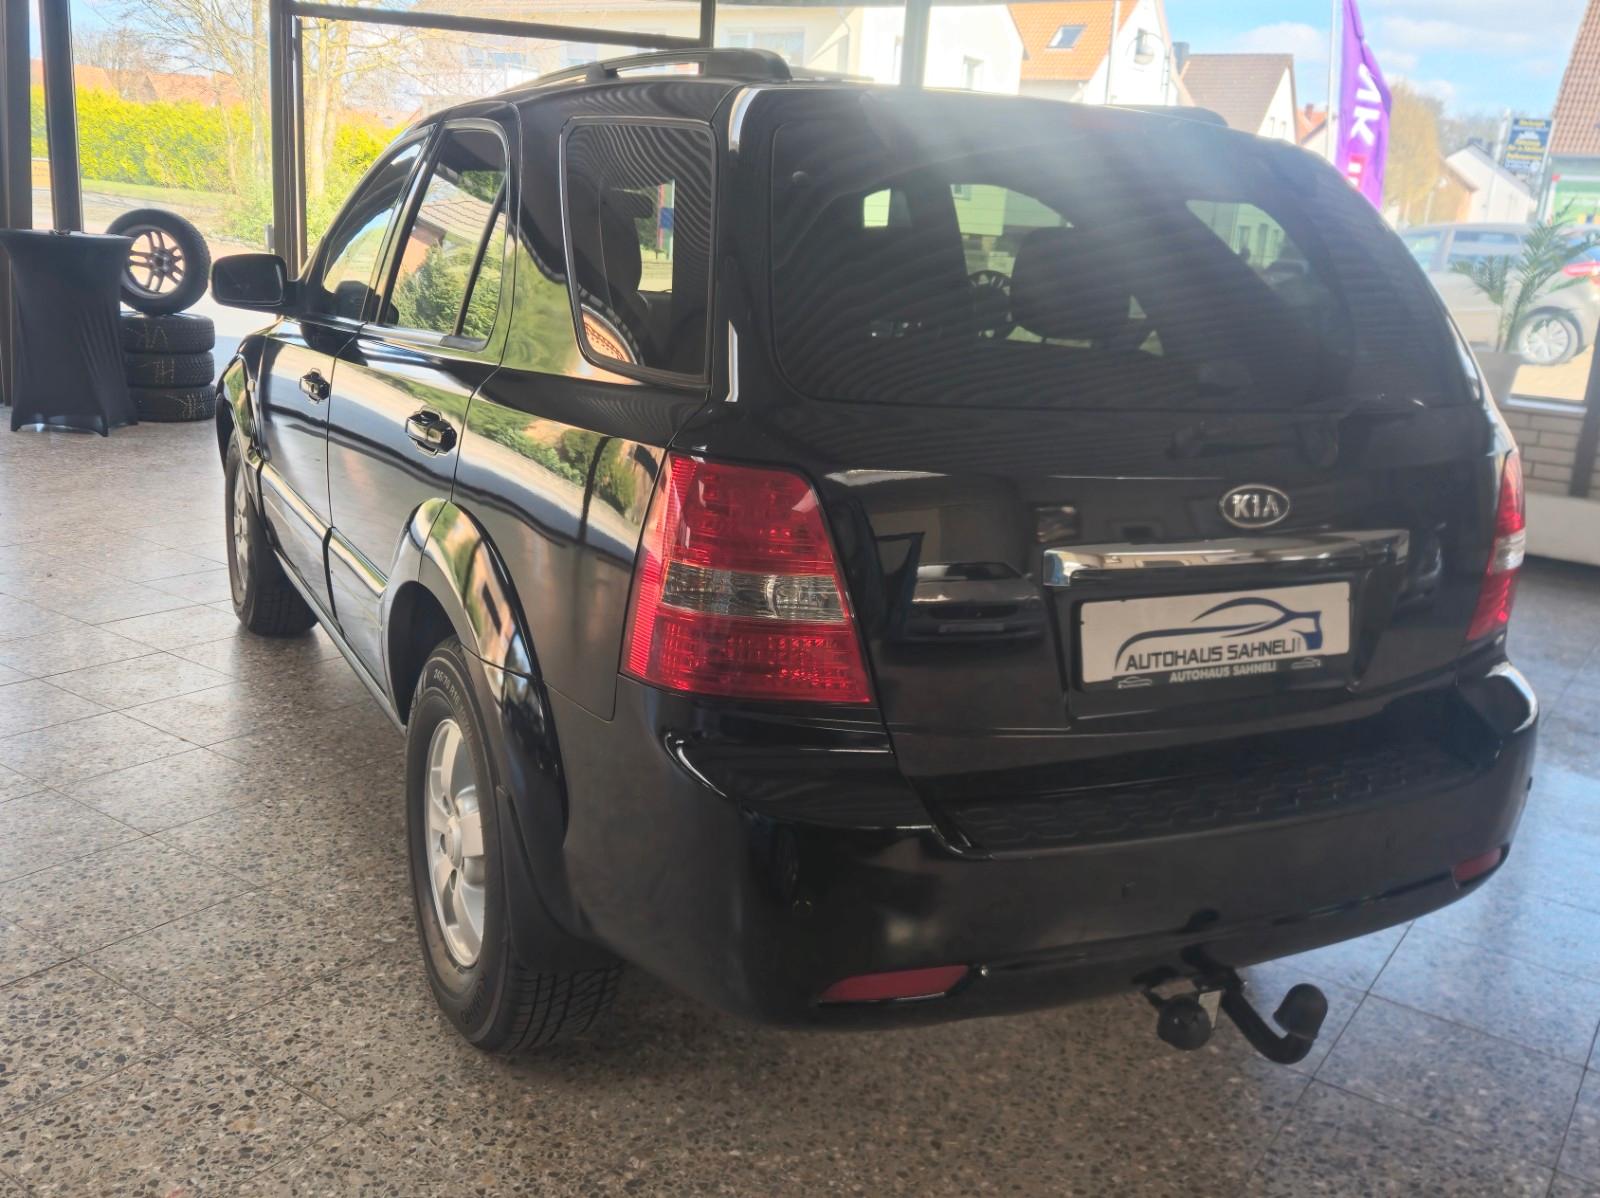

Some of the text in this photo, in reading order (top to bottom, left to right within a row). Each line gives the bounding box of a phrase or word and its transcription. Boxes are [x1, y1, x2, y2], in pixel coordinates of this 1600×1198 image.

[1232, 494, 1280, 518] KIA
[1125, 645, 1223, 672] AUTOHAUS
[1169, 661, 1277, 683] AUTOHAUS SAHNELI
